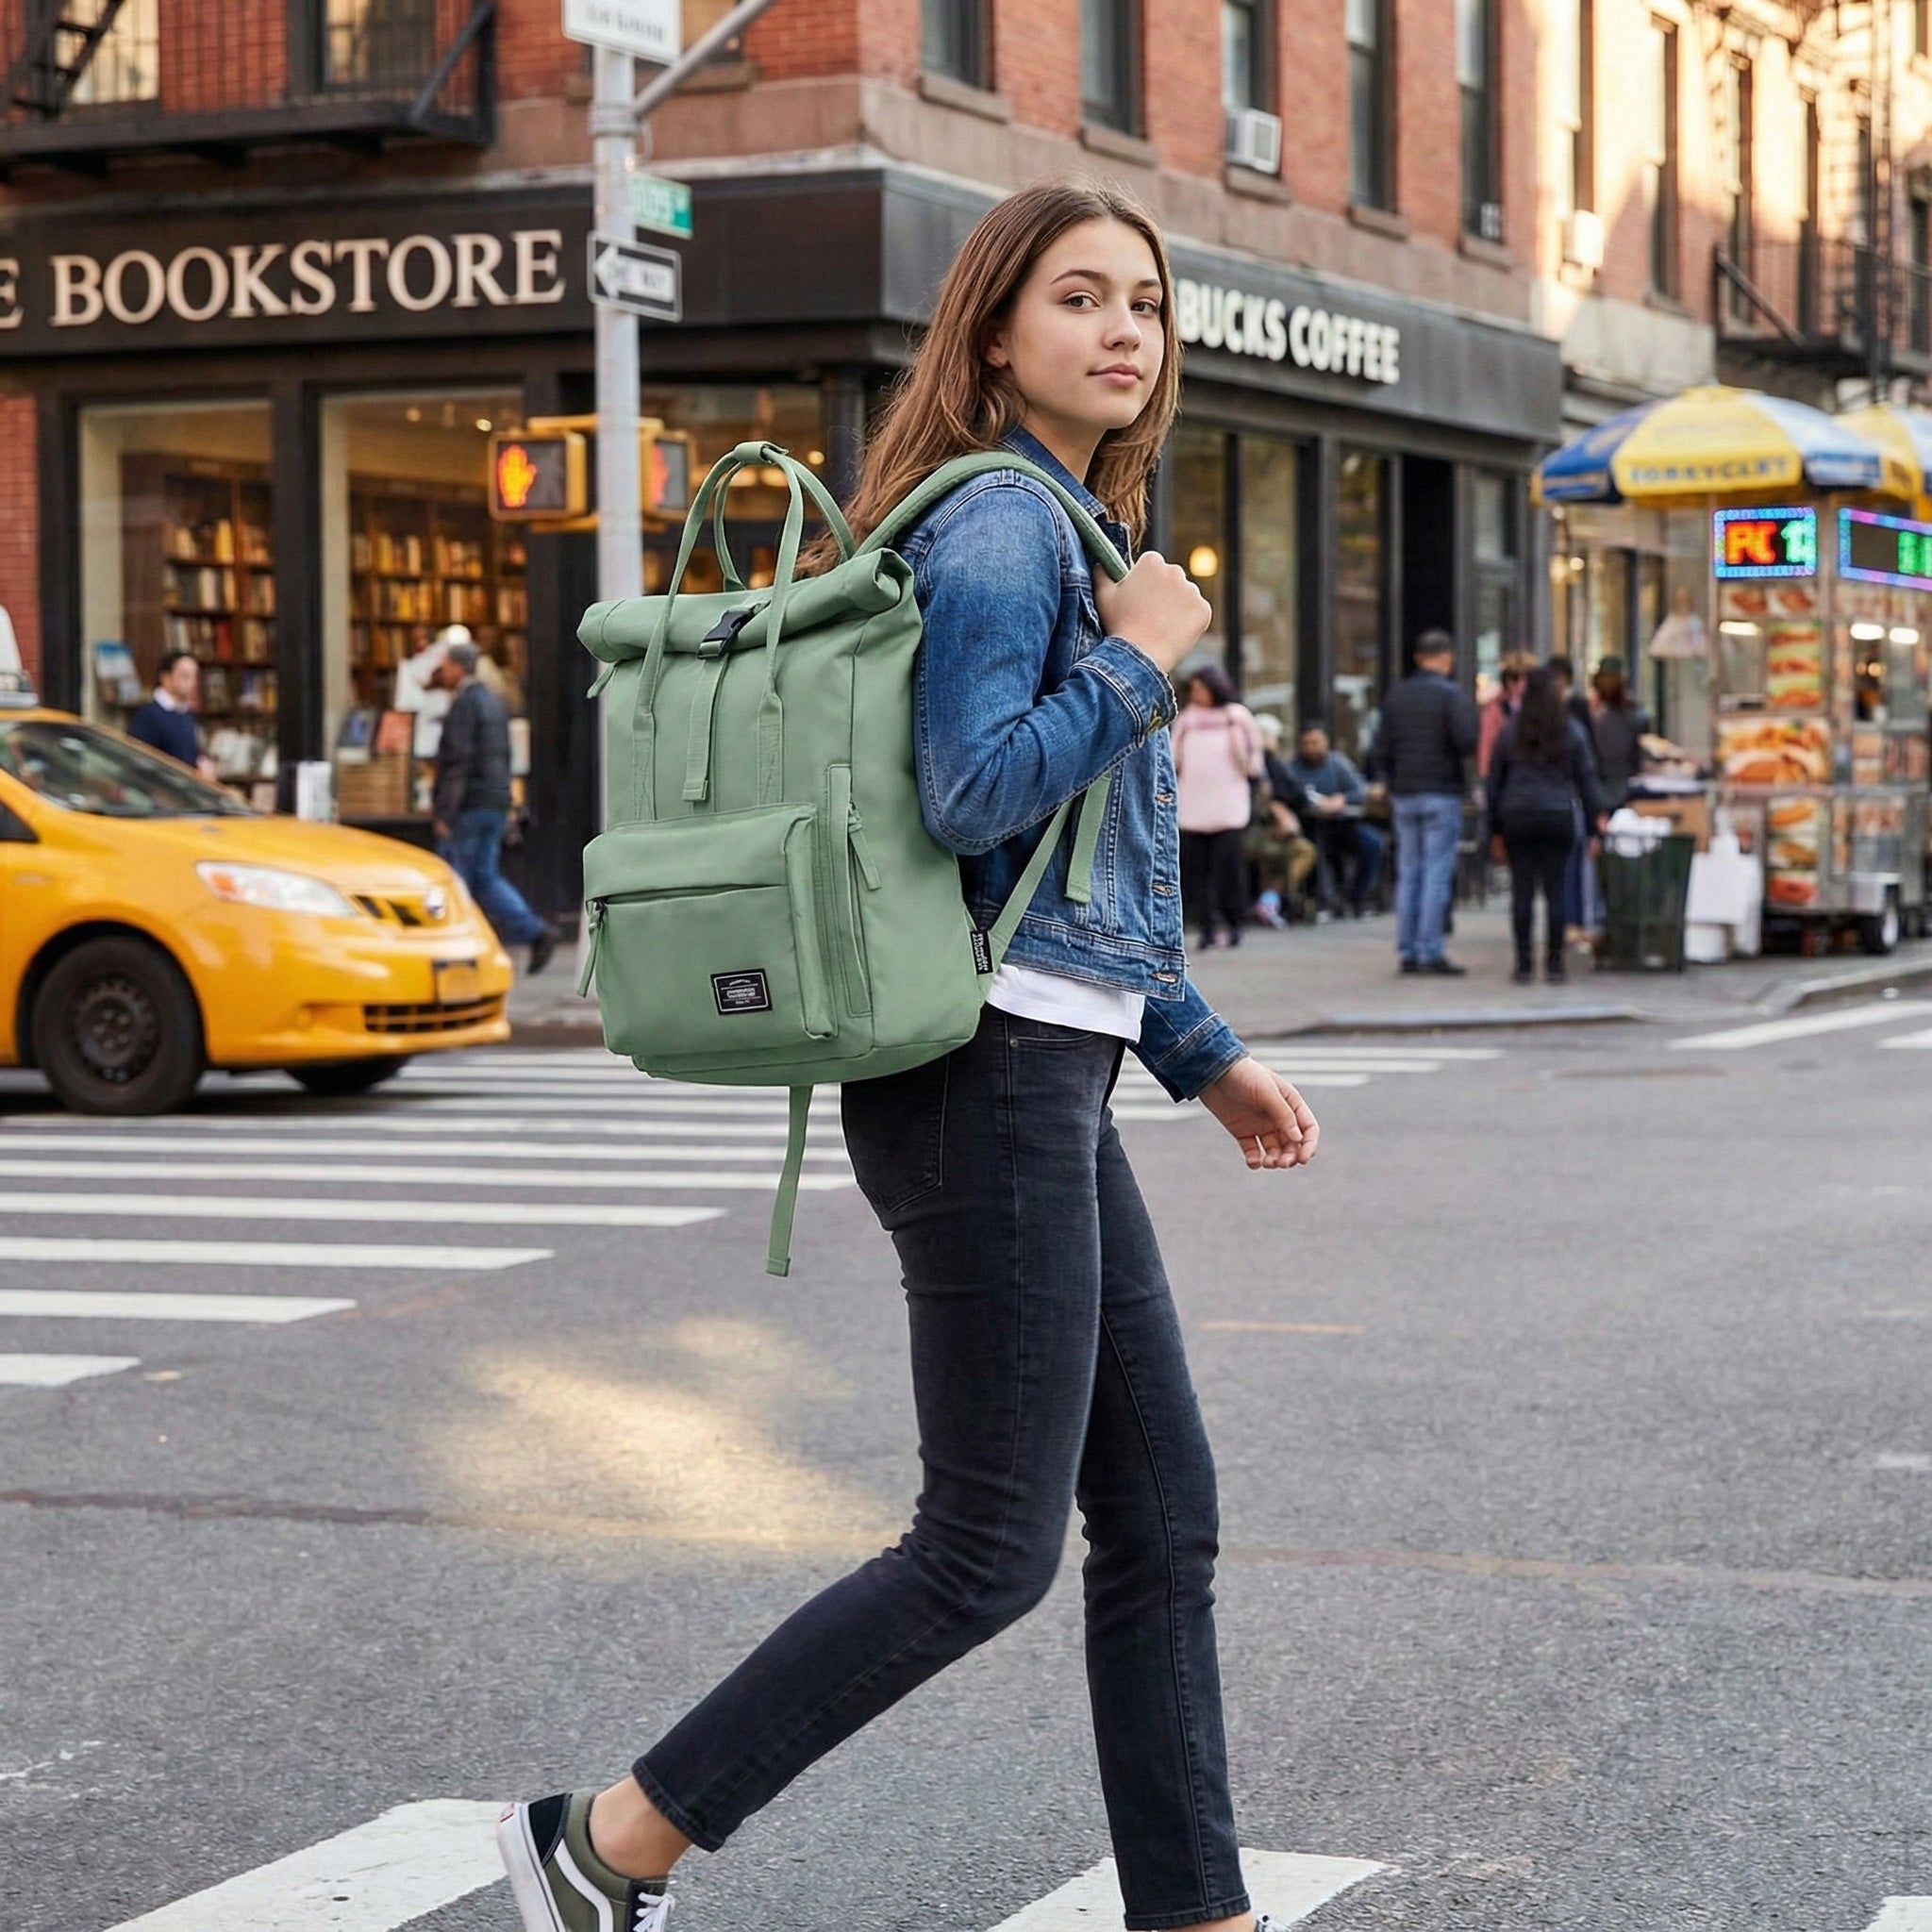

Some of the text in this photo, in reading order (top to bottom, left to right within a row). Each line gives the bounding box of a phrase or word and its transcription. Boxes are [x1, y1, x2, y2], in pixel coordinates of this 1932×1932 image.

[47, 228, 566, 327] BOOKSTORE
[1172, 277, 1401, 385] BUCKS COFFEE
